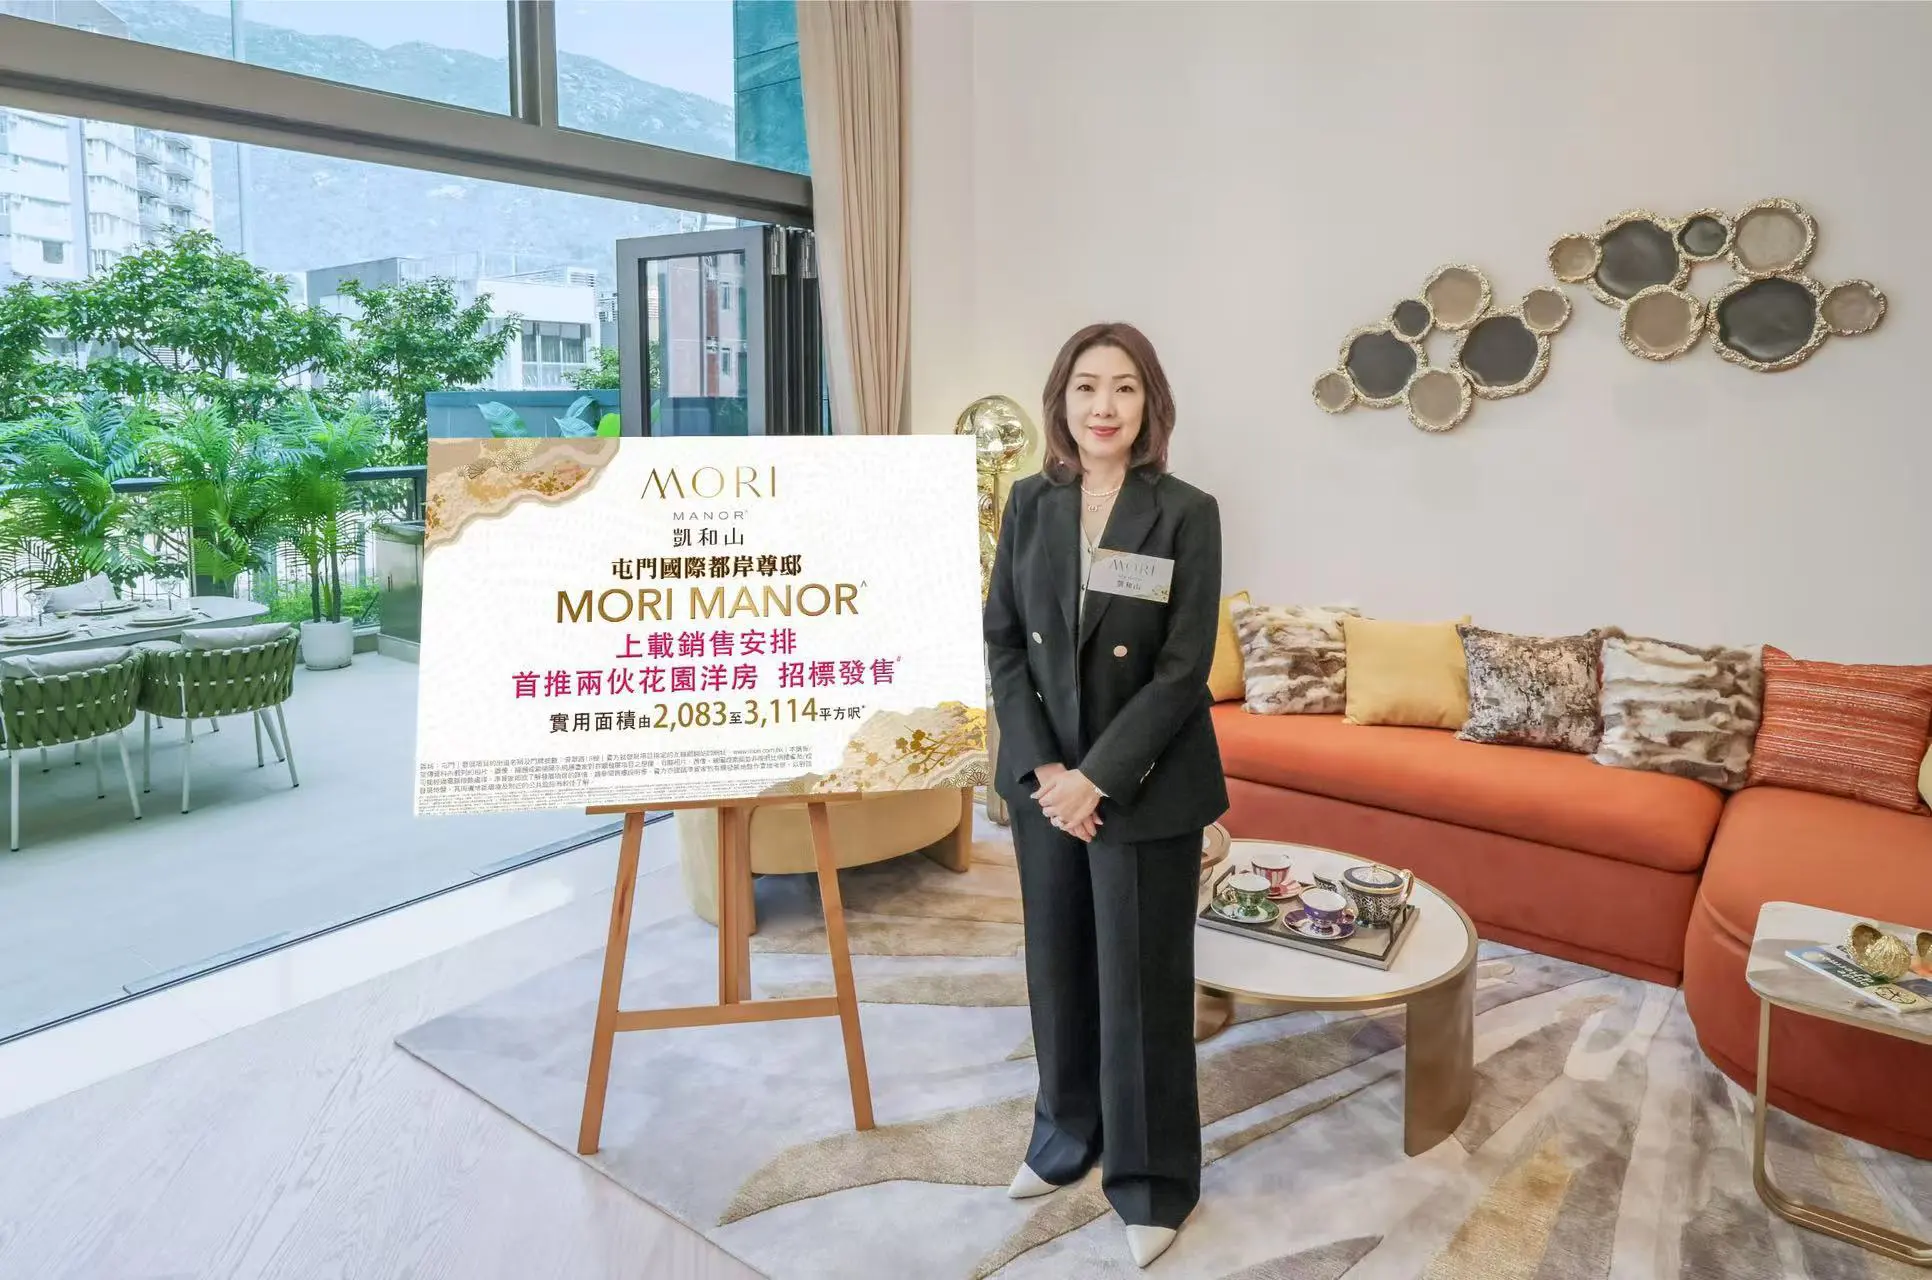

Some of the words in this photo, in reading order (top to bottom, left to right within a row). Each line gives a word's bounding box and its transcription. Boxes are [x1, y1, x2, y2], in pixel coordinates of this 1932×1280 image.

[641, 466, 776, 499] MORI
[672, 527, 744, 547] 凱和山
[611, 554, 802, 580] 屯門國際都岸尊邸
[557, 588, 673, 623] MORI
[616, 628, 798, 659] 上載銷售安排
[511, 662, 758, 699] 首推兩伙花園洋房
